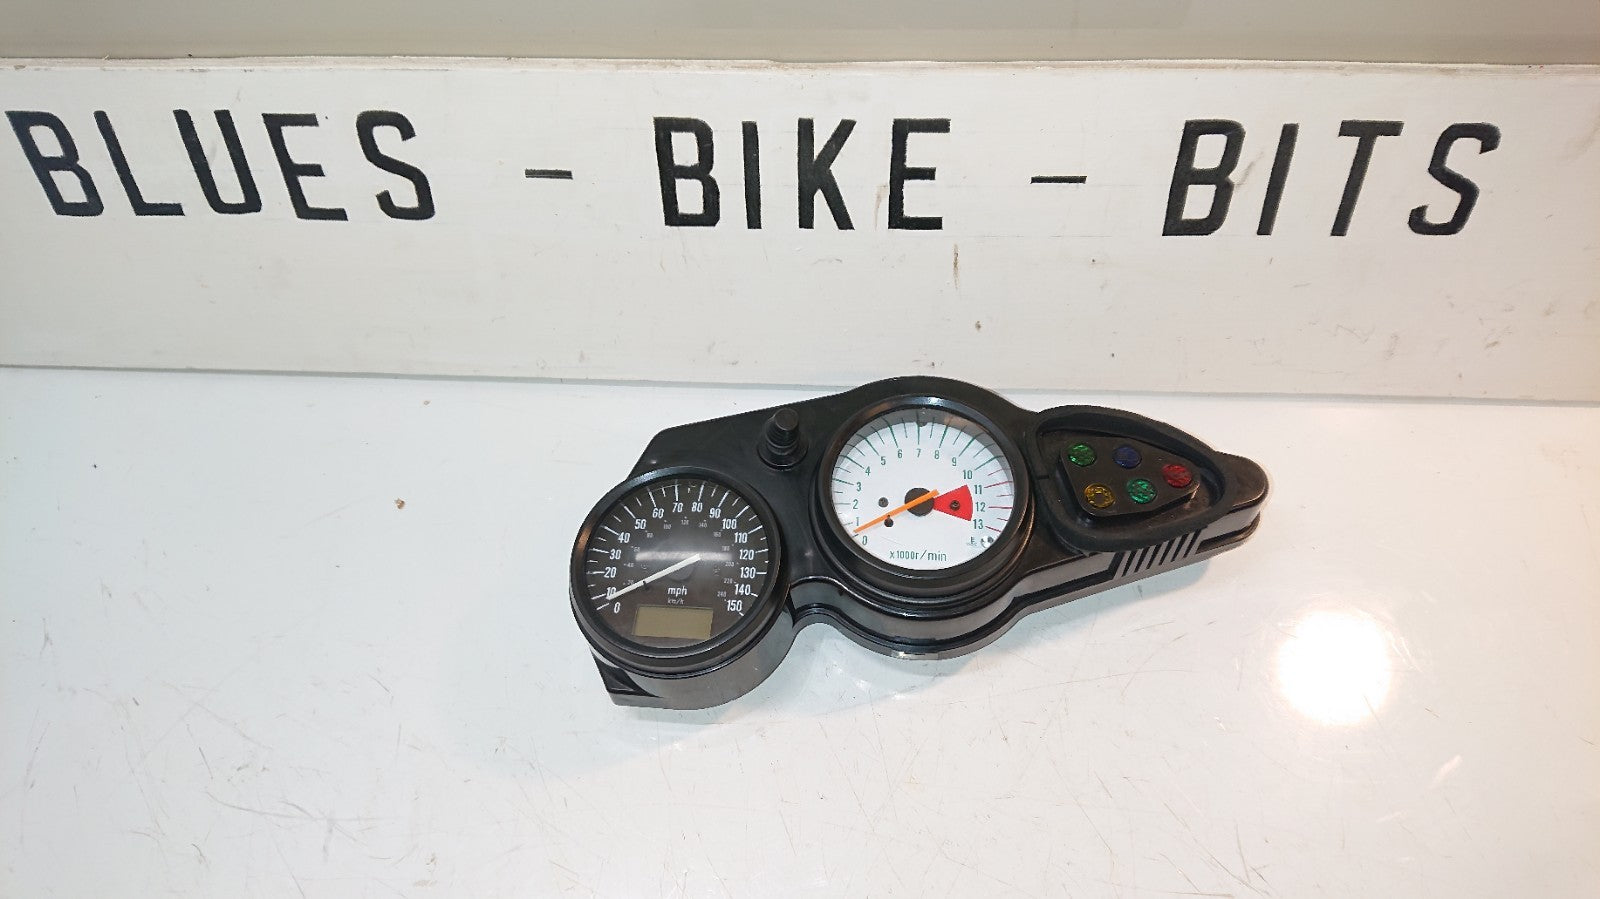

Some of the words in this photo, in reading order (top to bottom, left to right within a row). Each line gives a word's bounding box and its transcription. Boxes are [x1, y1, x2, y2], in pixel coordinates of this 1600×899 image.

[5, 110, 435, 220] BLUES
[653, 117, 951, 230] BIKE
[1162, 119, 1501, 236] BITS
[898, 449, 903, 458] 6
[916, 449, 921, 457] 7
[934, 450, 939, 459] 8
[881, 456, 886, 465] 5
[952, 457, 957, 466] 9
[865, 466, 870, 475] 4
[963, 469, 973, 479] 10
[857, 482, 861, 491] 3
[975, 485, 982, 494] 11
[672, 503, 683, 512] 70
[692, 502, 702, 512] 80
[853, 500, 858, 509] 2
[976, 502, 986, 511] 12
[653, 508, 664, 518] 60
[709, 508, 721, 518] 90
[635, 519, 646, 529] 50
[722, 519, 737, 529] 100
[856, 517, 859, 525] 1
[973, 519, 983, 529] 13
[618, 533, 630, 542] 40
[734, 533, 747, 543] 110
[862, 536, 867, 545] 0
[610, 550, 621, 559] 30
[739, 550, 754, 560] 120
[604, 567, 616, 578] 20
[740, 567, 755, 577] 130
[606, 587, 616, 598] 10
[668, 587, 687, 595] mph
[735, 585, 750, 595] 140
[614, 603, 620, 613] 0
[727, 600, 742, 611] 150
